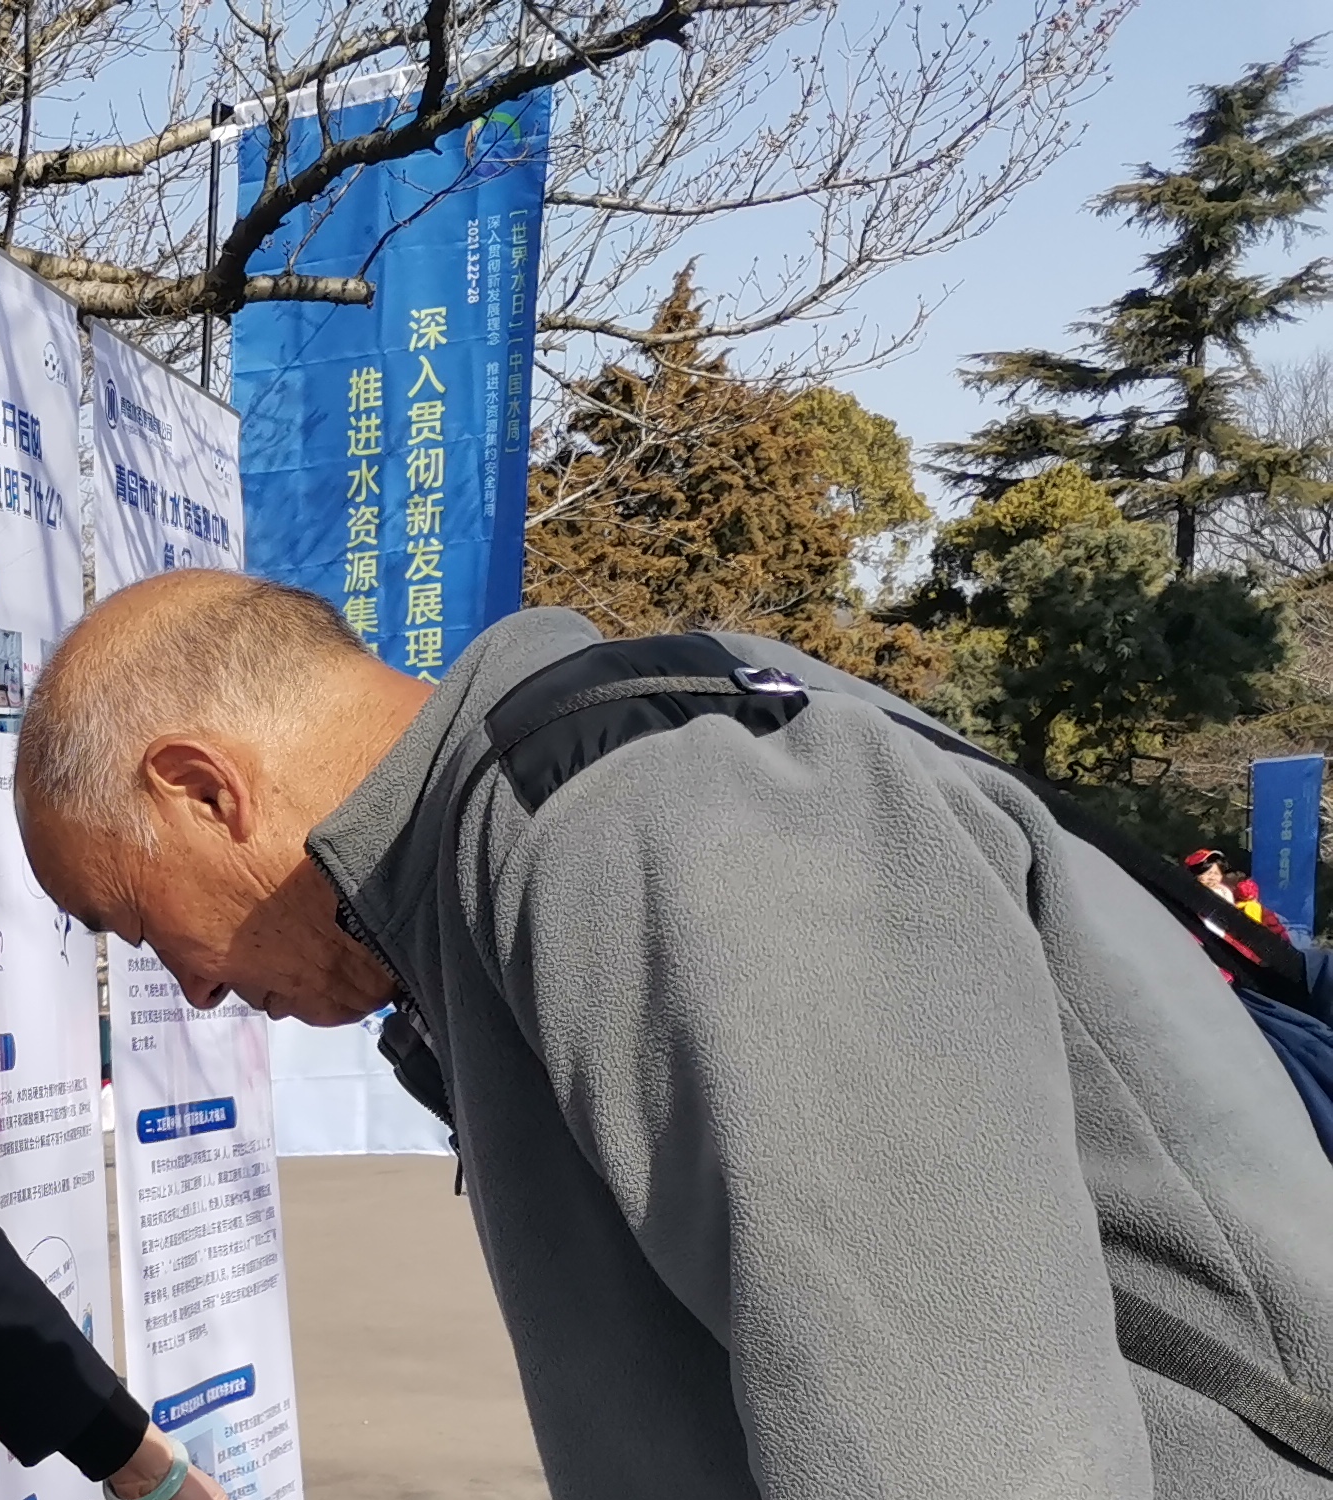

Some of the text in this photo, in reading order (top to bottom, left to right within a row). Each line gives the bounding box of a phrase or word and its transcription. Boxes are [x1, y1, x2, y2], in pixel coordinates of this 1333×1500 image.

[115, 464, 230, 551] 青岛市供水水质监测中心
[342, 366, 384, 657] 推进水资源集
